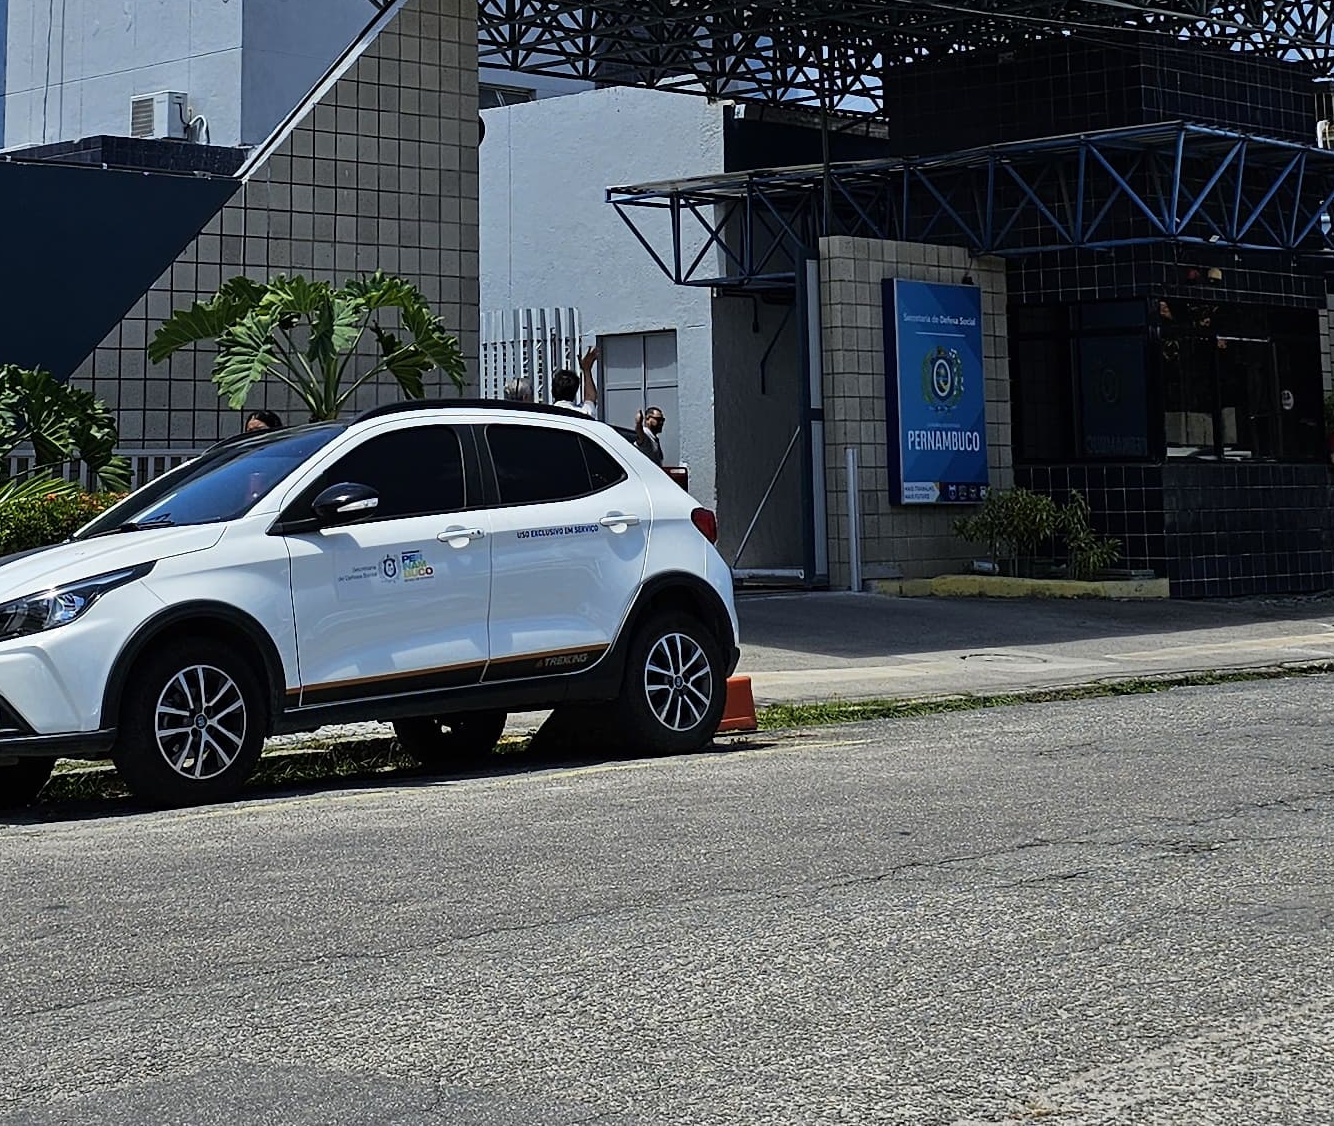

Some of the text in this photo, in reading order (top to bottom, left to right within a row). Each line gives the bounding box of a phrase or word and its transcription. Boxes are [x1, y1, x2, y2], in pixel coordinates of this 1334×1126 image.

[959, 317, 976, 326] Social
[908, 430, 980, 451] PERNAMBUCO
[531, 528, 564, 537] EXCLUSIVO
[564, 526, 573, 534] EM
[574, 524, 598, 533] SERVIÇO
